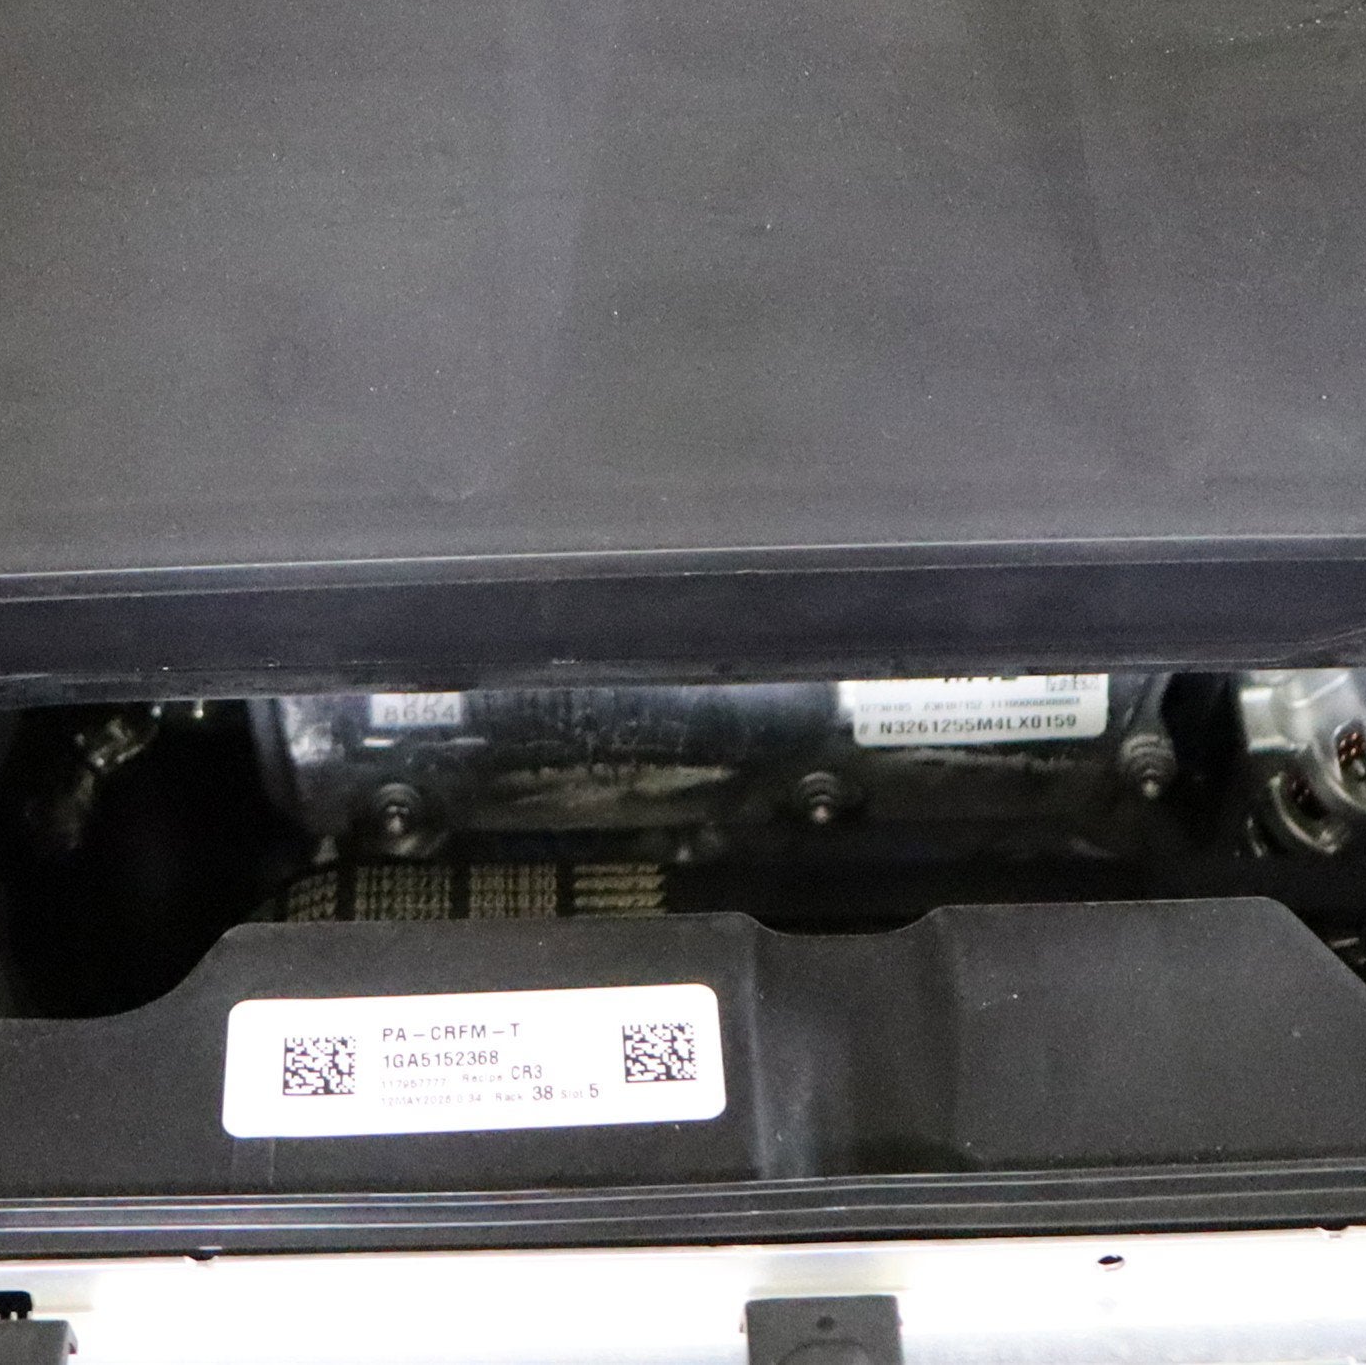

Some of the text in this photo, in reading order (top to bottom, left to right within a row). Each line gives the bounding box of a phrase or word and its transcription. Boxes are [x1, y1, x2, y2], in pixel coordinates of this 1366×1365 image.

[382, 1050, 499, 1069] 1GA5152368
[462, 1074, 504, 1084] Recipe
[511, 1064, 543, 1081] CR3
[495, 1091, 523, 1102] Rack
[532, 1084, 554, 1101] 38
[561, 1089, 584, 1099] Slot
[589, 1082, 600, 1099] 5
